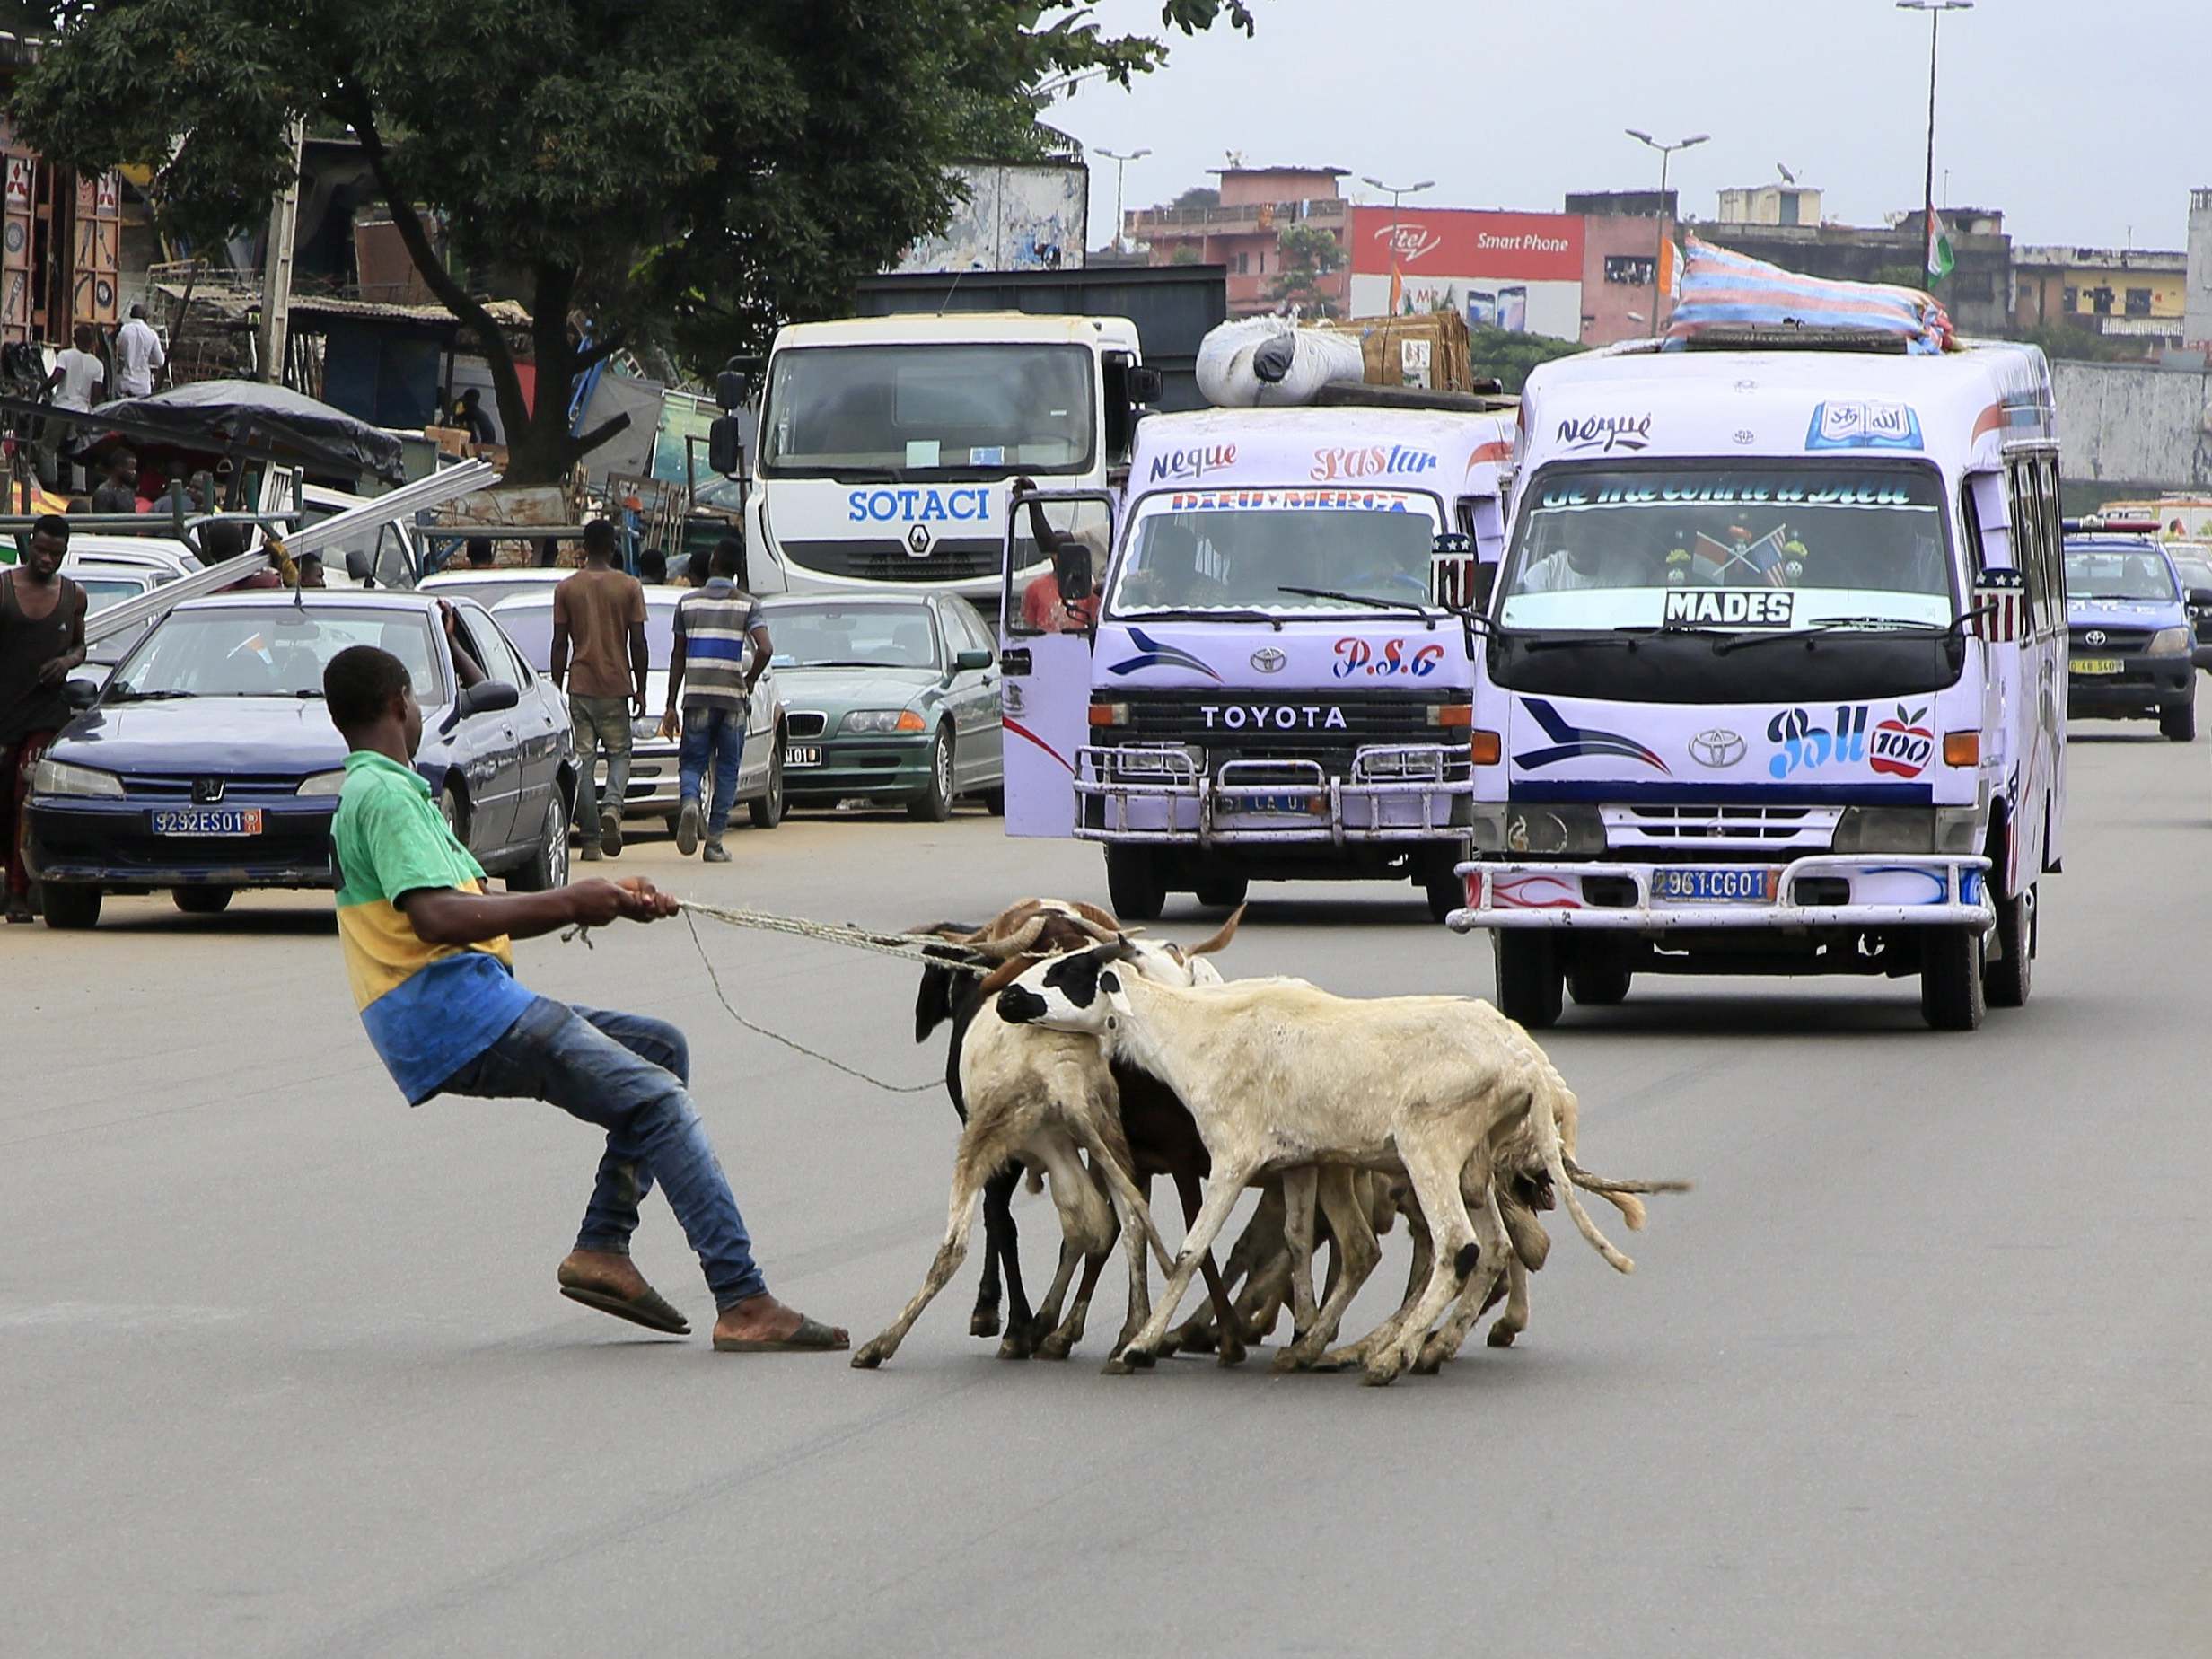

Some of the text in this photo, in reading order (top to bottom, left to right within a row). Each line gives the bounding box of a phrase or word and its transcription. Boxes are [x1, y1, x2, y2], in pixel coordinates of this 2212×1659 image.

[1478, 233, 1568, 251] Smart Phone
[849, 489, 990, 521] SOTACI
[1667, 593, 1791, 623] MADES
[1333, 637, 1444, 678] P.S.G
[1200, 706, 1347, 729] TOYOTA
[1877, 733, 1930, 762] 100
[156, 812, 241, 831] 9292ES01
